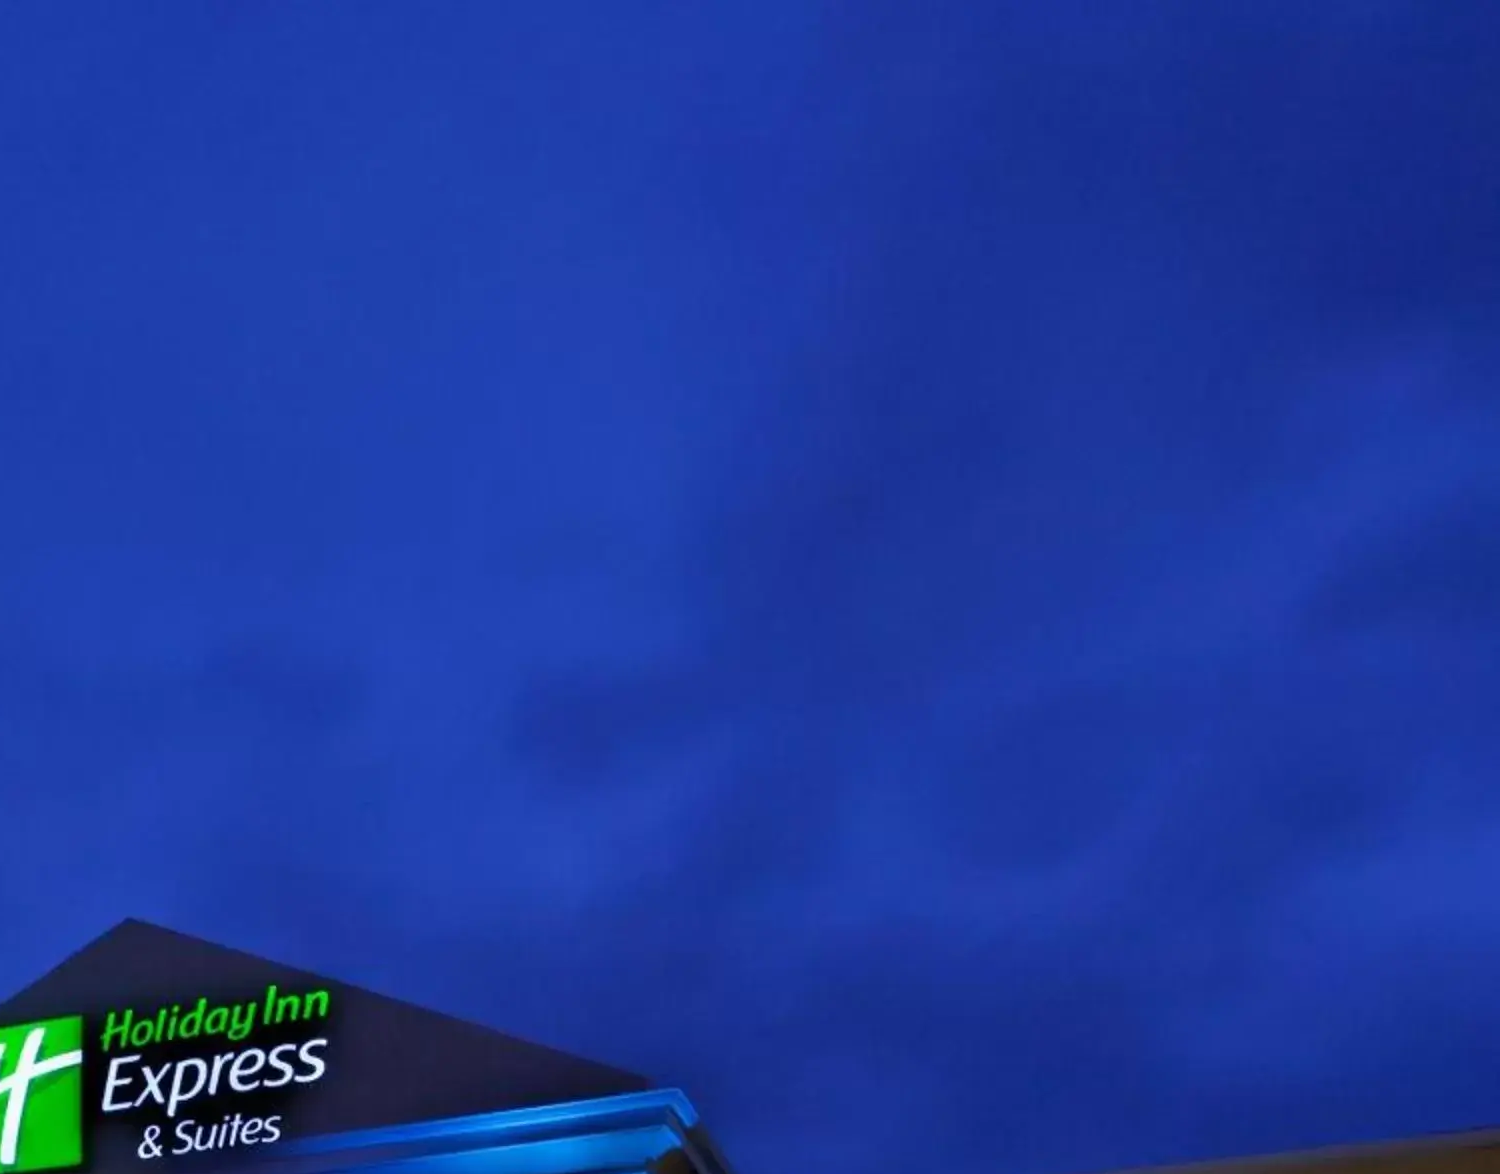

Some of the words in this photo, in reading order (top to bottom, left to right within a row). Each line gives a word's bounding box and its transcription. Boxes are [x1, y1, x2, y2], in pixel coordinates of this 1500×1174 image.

[101, 998, 257, 1052] Holiday
[261, 985, 330, 1026] Inn
[101, 1038, 328, 1117] Express
[137, 1124, 163, 1160] &
[171, 1113, 282, 1156] Suites
